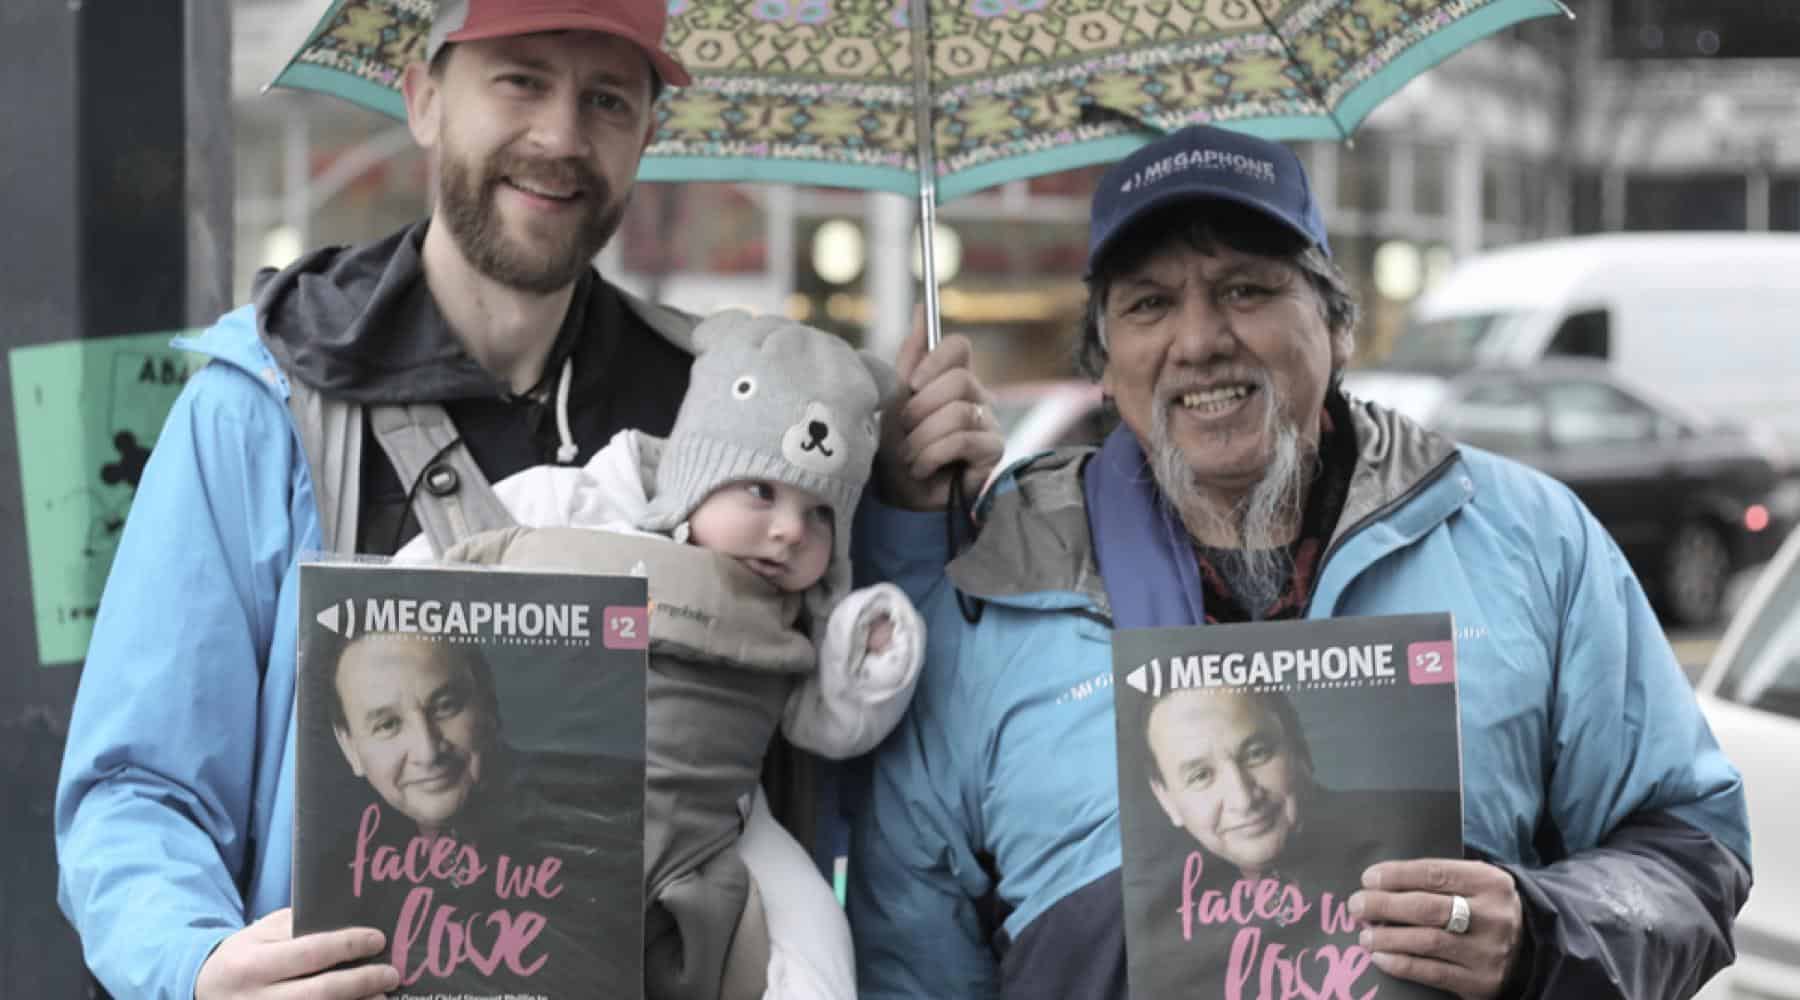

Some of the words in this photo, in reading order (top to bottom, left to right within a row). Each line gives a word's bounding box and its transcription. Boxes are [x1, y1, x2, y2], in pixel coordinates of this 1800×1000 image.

[1144, 149, 1275, 180] MEGAPHONE
[364, 598, 590, 637] MEGAPHONE
[610, 616, 637, 639] $2
[1170, 644, 1397, 689] MEGAPHONE
[1415, 650, 1443, 673] $2
[349, 803, 487, 898] faces
[495, 855, 564, 900] we
[1177, 851, 1313, 941] faces
[391, 886, 548, 987] love
[1224, 927, 1380, 1000] love
